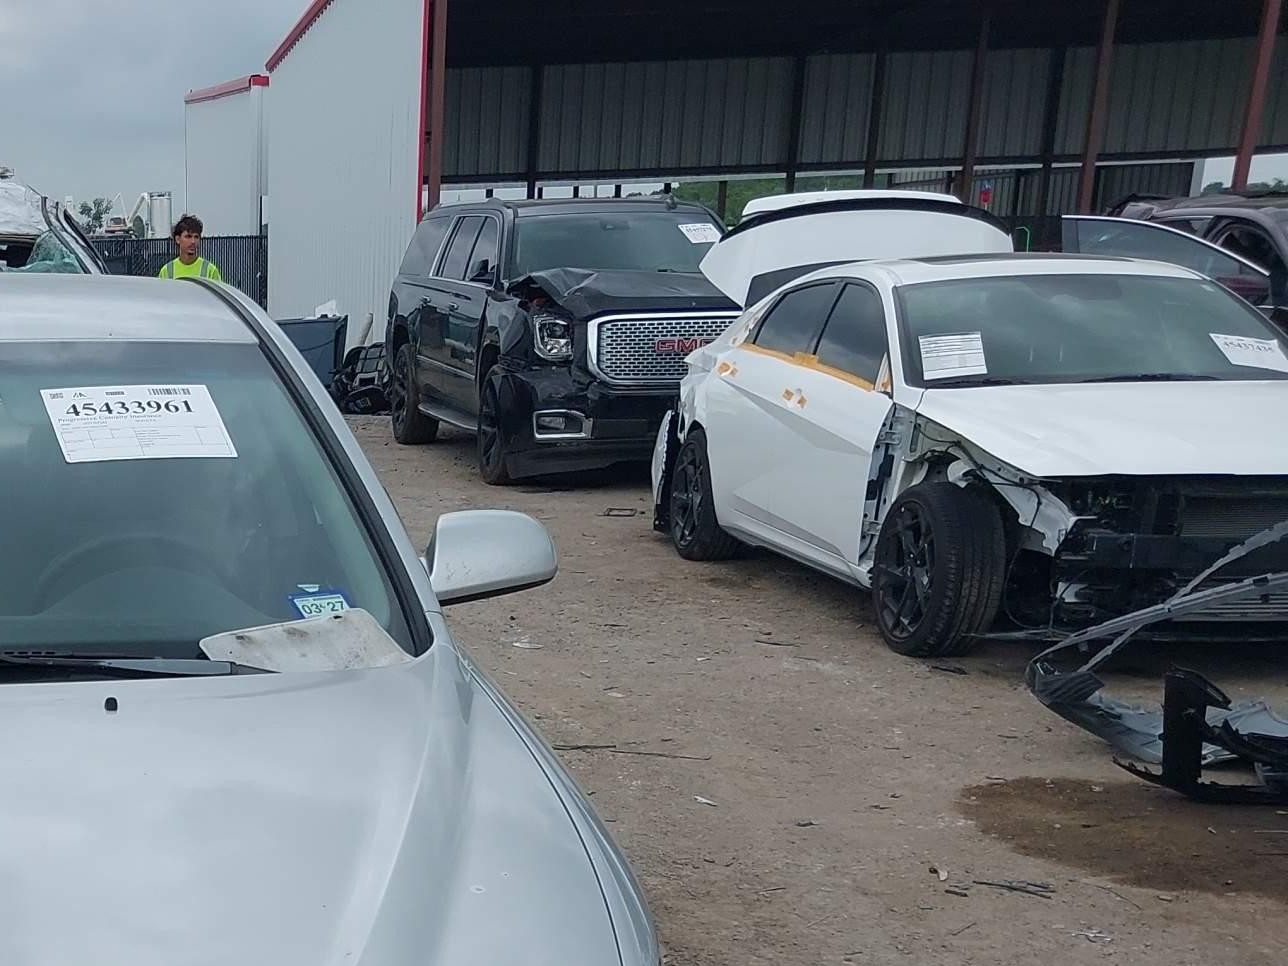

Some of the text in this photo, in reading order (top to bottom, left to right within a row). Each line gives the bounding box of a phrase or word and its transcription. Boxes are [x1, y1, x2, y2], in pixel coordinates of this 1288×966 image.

[65, 399, 194, 417] 45433961
[301, 601, 345, 615] 03 27
